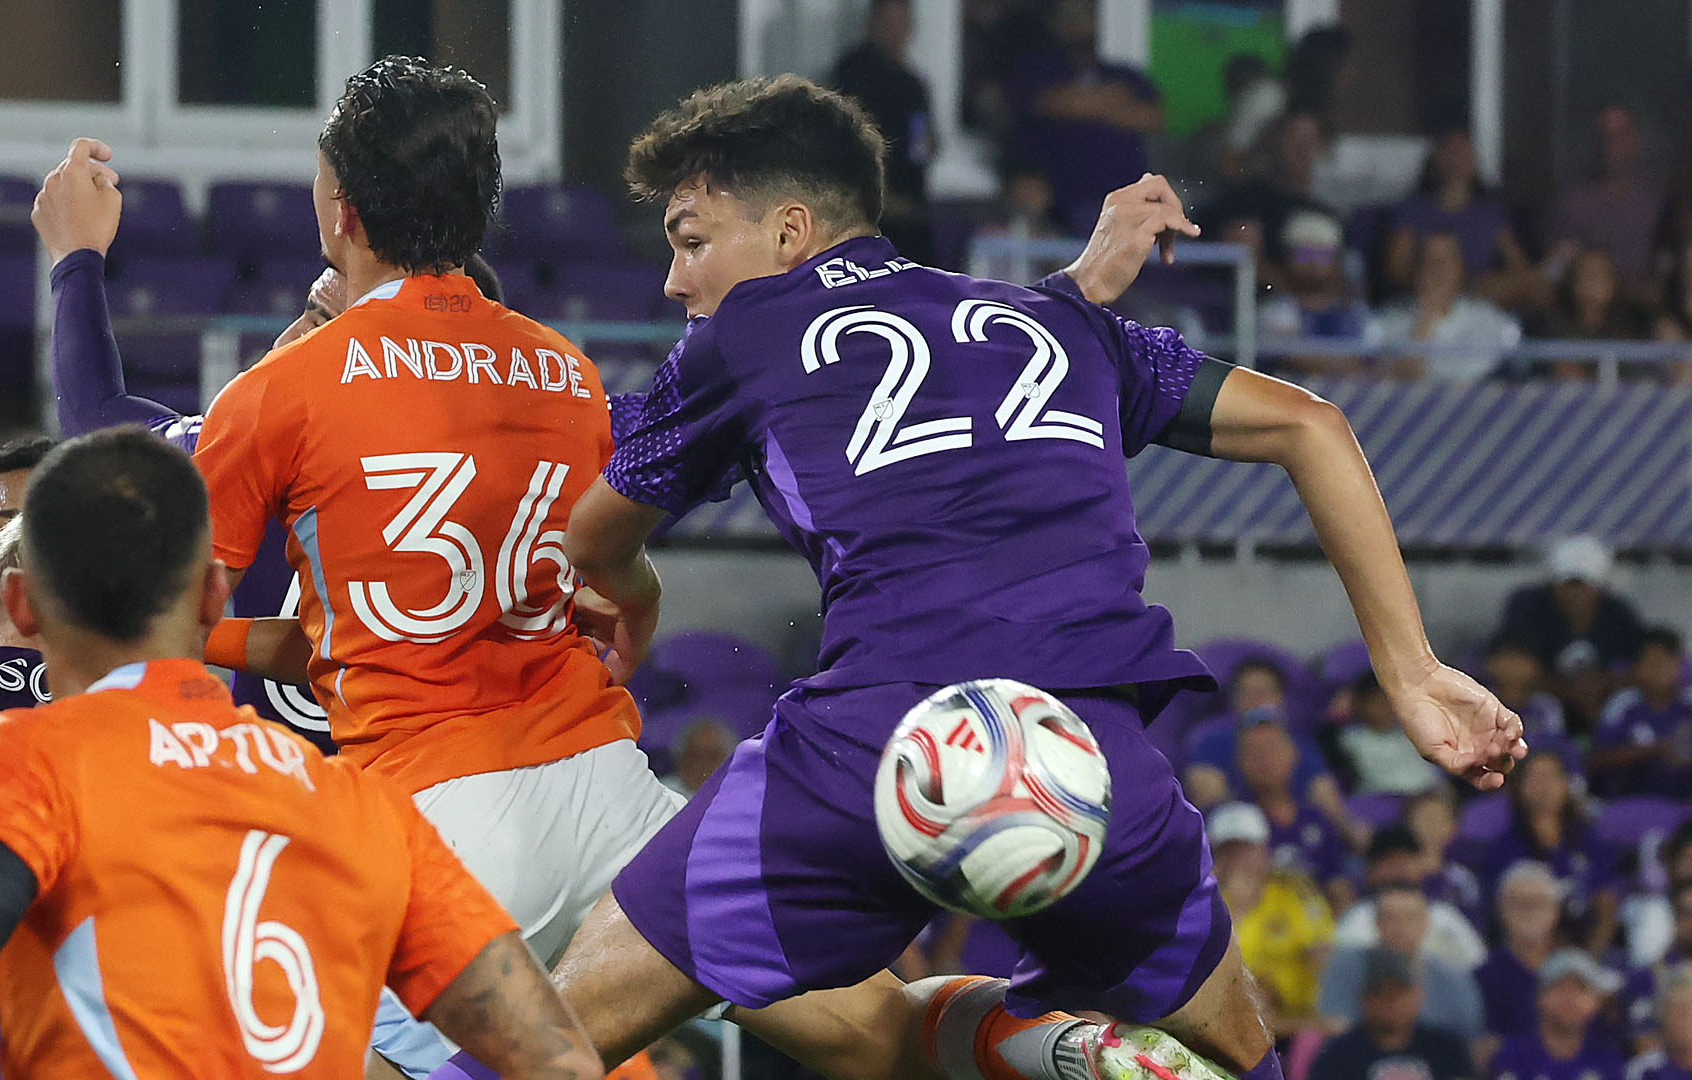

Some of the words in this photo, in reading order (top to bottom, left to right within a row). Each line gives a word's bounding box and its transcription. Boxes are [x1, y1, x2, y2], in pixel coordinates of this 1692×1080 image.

[340, 336, 592, 399] ANDRADE
[800, 299, 1105, 477] 22
[347, 452, 576, 644] 36
[222, 829, 325, 1074] 6
